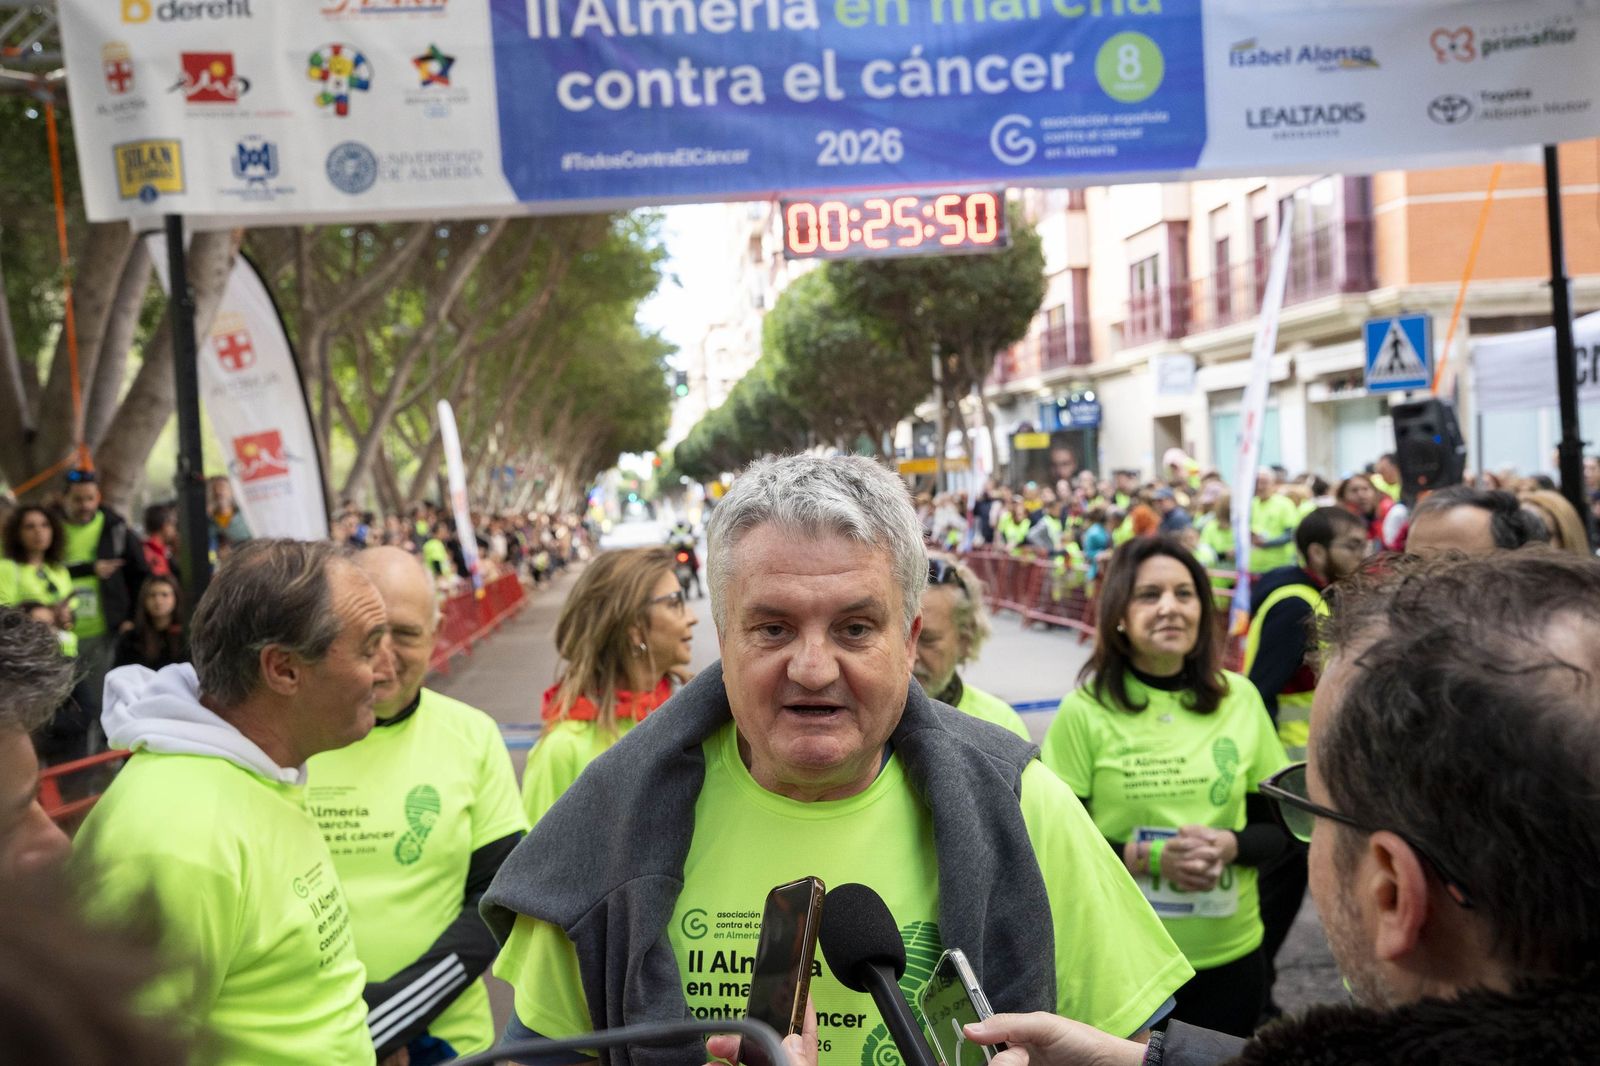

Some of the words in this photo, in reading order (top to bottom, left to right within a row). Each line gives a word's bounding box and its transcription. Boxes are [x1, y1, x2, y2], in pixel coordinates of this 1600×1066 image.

[1117, 43, 1143, 81] 8
[1229, 47, 1293, 69] Isabel
[556, 57, 767, 112] contra
[783, 49, 845, 102] el
[860, 45, 1074, 99] cáncer
[1246, 102, 1366, 129] LEALTADIS
[815, 128, 904, 166] 2026
[785, 192, 999, 253] 00:25:50
[715, 921, 743, 929] contra
[716, 911, 761, 919] asociación
[726, 931, 761, 940] Almería
[688, 950, 704, 973] II
[686, 981, 713, 996] en
